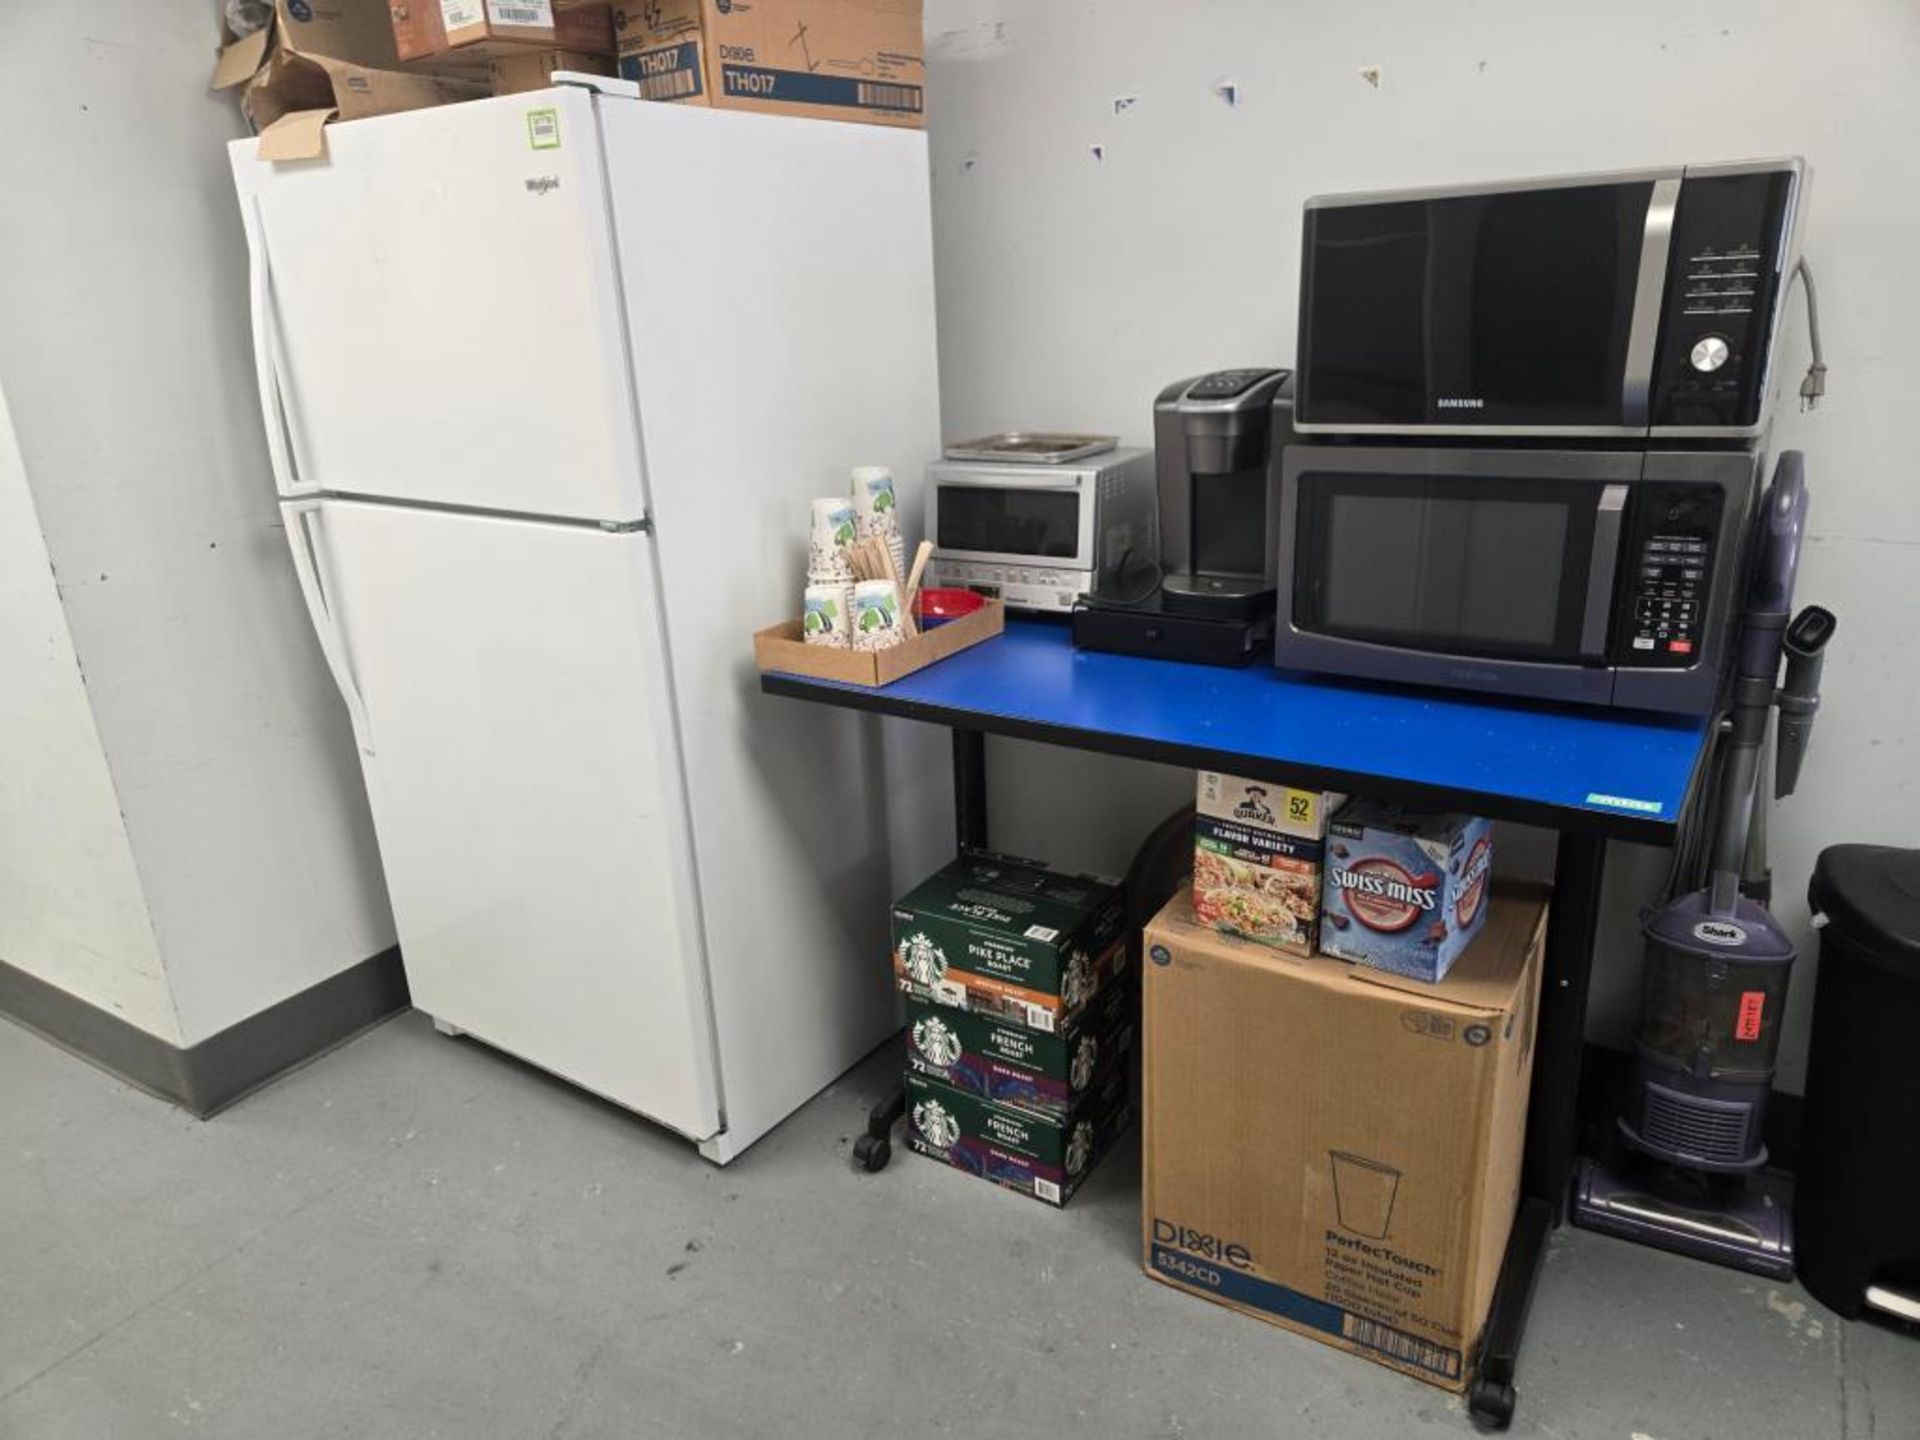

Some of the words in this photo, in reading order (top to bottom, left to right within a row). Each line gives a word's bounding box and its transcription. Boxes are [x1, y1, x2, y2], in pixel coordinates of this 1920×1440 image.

[638, 49, 678, 75] TH017
[726, 70, 776, 93] TH017
[1438, 398, 1484, 408] SAMSUNG
[1233, 807, 1275, 825] QUAKER
[1290, 796, 1309, 816] 52
[1213, 827, 1250, 843] FLAVOR
[1251, 835, 1296, 854] VARIETY
[1702, 925, 1736, 938] Shark
[968, 944, 993, 960] PIKE
[995, 951, 1033, 969] PLACE
[987, 960, 1012, 973] ROAST
[899, 978, 913, 993] 72
[991, 1032, 1034, 1055] FRENCH
[911, 1058, 926, 1072] 72
[987, 1118, 1029, 1141] FRENCH
[914, 1139, 927, 1152] 72
[1158, 1251, 1220, 1286] 5342CD
[1325, 1257, 1364, 1276] Paper
[1366, 1272, 1389, 1286] Hot
[1326, 1247, 1338, 1257] 12
[1361, 1258, 1423, 1287] Insulated
